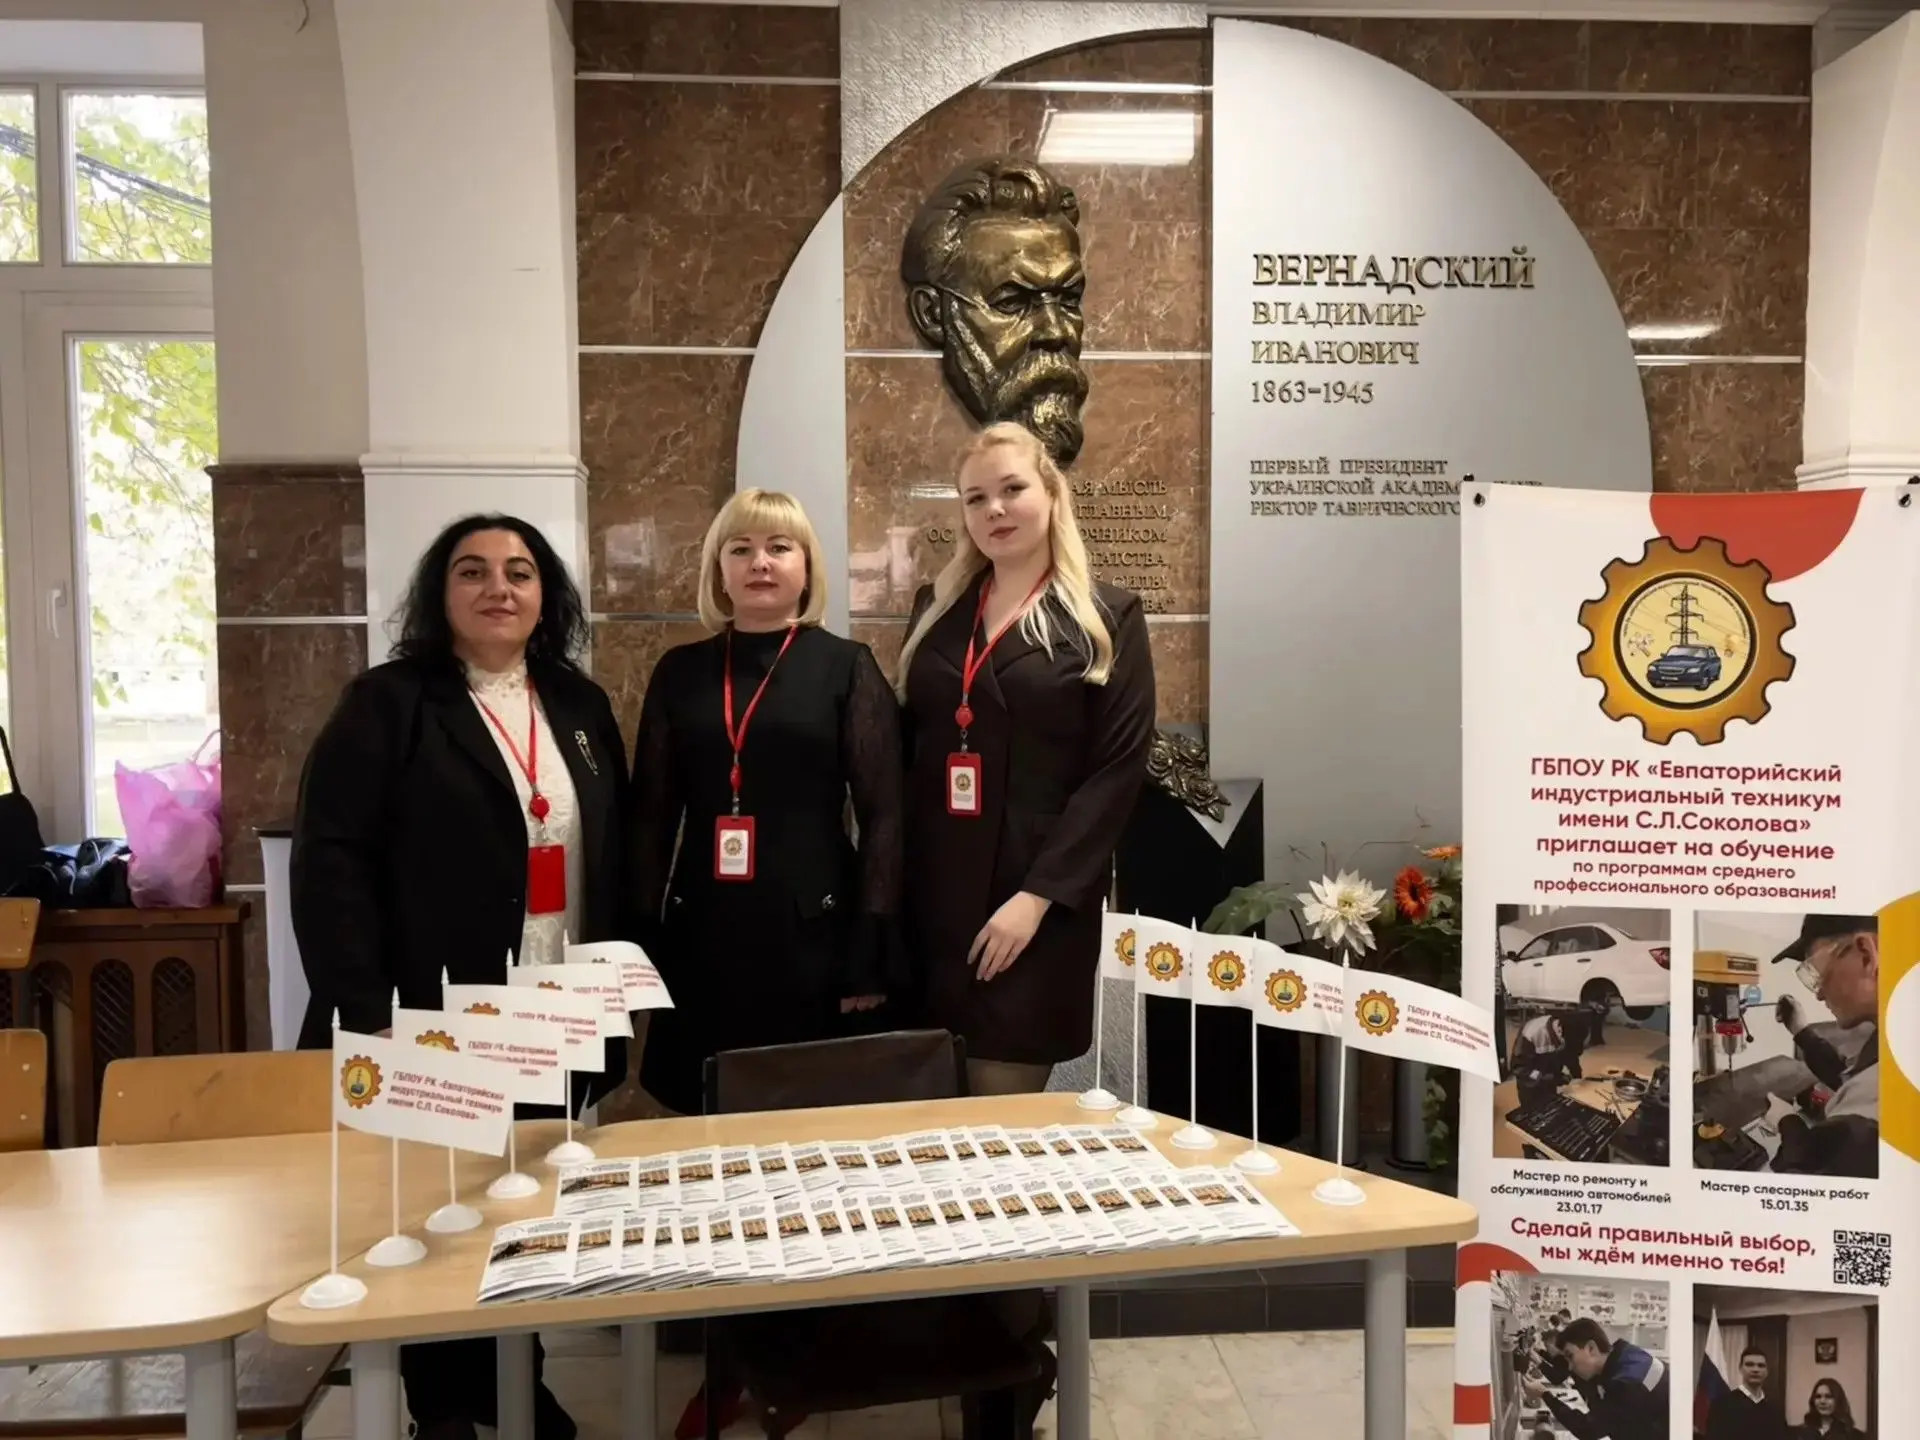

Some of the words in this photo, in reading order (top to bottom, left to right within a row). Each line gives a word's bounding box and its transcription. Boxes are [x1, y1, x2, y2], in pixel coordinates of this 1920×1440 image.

[1252, 244, 1536, 294] ВЕРНАДСКИЙ
[1252, 301, 1425, 328] ВЛАДИМИР
[1251, 341, 1419, 364] ИВАНОВИЧ
[1251, 380, 1374, 403] 1863-1945
[1250, 457, 1330, 475] ПЕРВЫЙ
[1340, 459, 1448, 476] ПРЕЗИДЕНТ
[1100, 480, 1168, 496] МЫСЛЬ
[1250, 477, 1374, 496] УКРАИНСКОЙ
[1381, 479, 1461, 498] АКАДЕМ
[1250, 501, 1317, 516] РЕКТОР
[1531, 758, 1604, 777] ГБПОУ
[1612, 759, 1640, 778] РК
[1648, 761, 1841, 784] «Евпаторийский
[1531, 785, 1724, 807] индустриальный
[1731, 791, 1841, 811] техникум
[1558, 811, 1629, 829] имени
[1636, 811, 1811, 833] С.Л.Соколова»
[1536, 837, 1678, 856] приглашает
[1685, 842, 1713, 856] на
[1720, 839, 1835, 861] обучение
[1573, 861, 1593, 873] по
[1598, 862, 1707, 878] программам
[1712, 865, 1796, 880] среднего
[1534, 878, 1709, 897] профессионального
[1714, 884, 1836, 900] образования!
[392, 1070, 423, 1084] ГБПОУ
[424, 1076, 437, 1087] РК
[1513, 1170, 1561, 1185] Мастер
[1564, 1174, 1579, 1186] по
[1582, 1175, 1637, 1189] ремонту
[1639, 1177, 1648, 1188] и
[1700, 1179, 1750, 1196] Мастер
[1753, 1184, 1826, 1200] слесарных
[1828, 1187, 1870, 1202] работ
[1490, 1185, 1583, 1201] обслуживанию
[1587, 1190, 1671, 1204] автомобилей
[1556, 1201, 1602, 1215] 23.01.17
[1760, 1199, 1809, 1213] 15.01.35
[1510, 1217, 1592, 1239] Сделай
[1599, 1226, 1733, 1249] правильный
[1740, 1232, 1816, 1256] выбор,
[1540, 1245, 1571, 1261] мы
[1577, 1247, 1635, 1266] ждём
[1642, 1254, 1723, 1272] именно
[1730, 1257, 1785, 1275] тебя!
